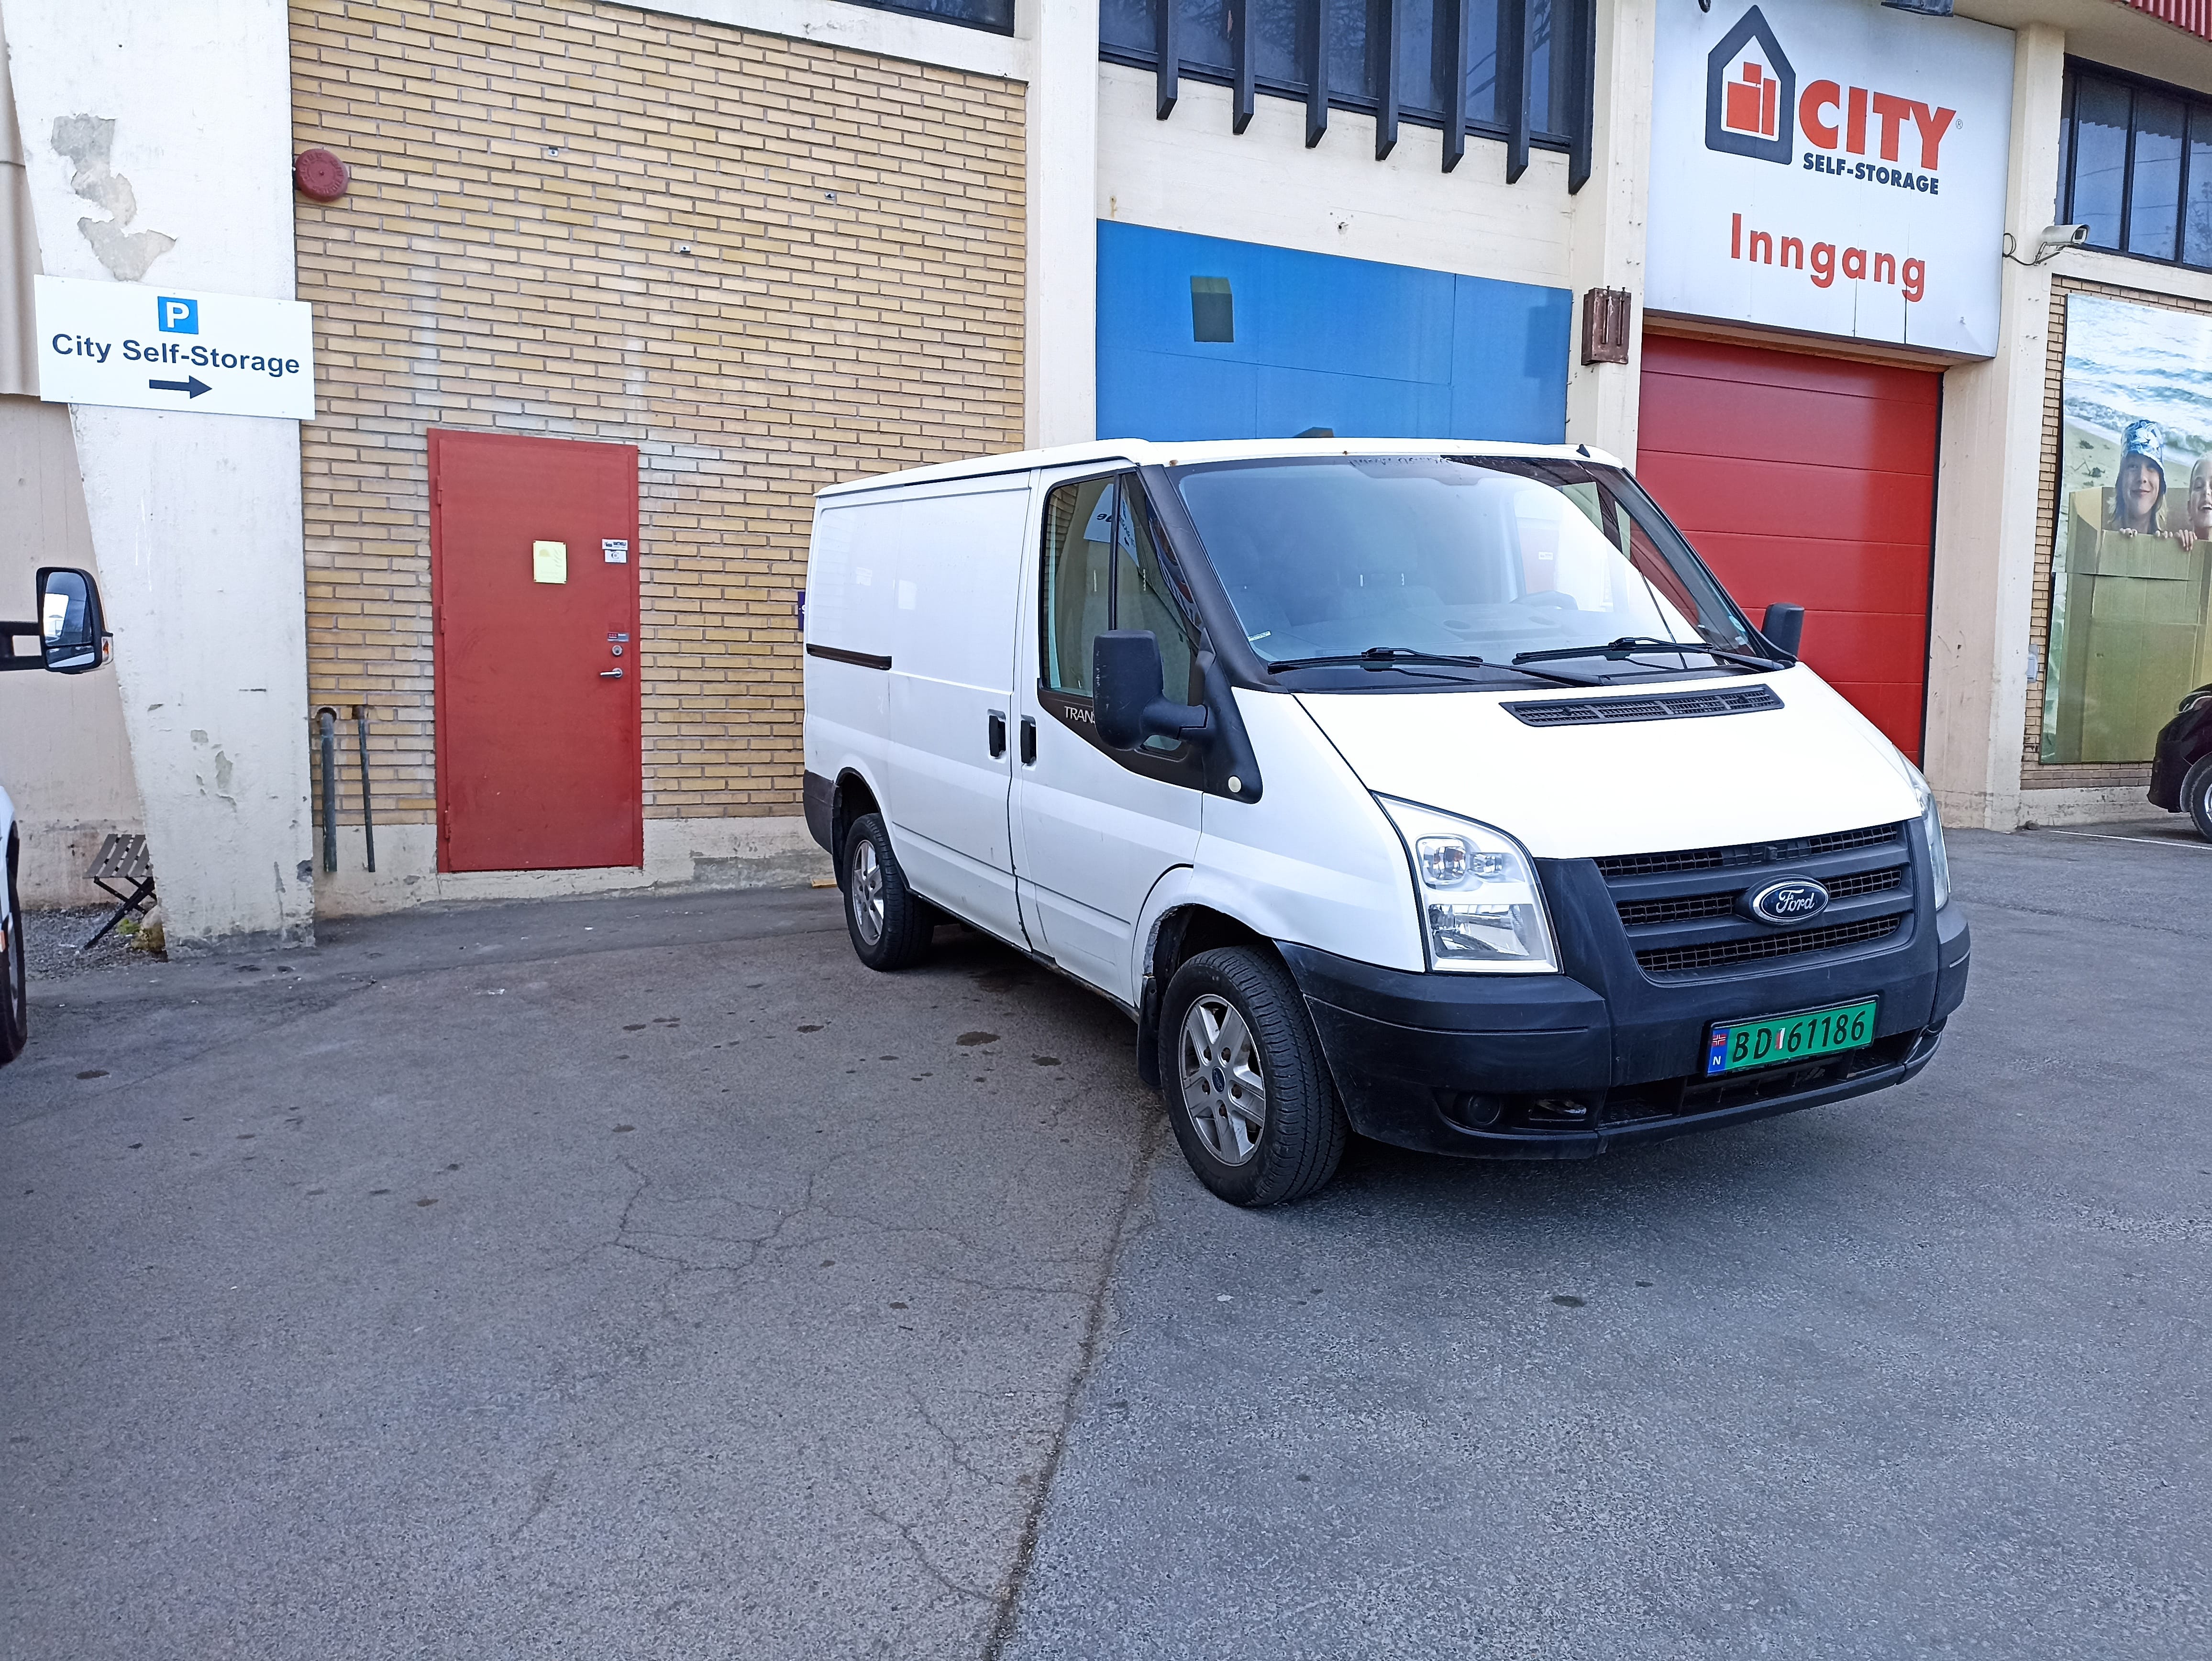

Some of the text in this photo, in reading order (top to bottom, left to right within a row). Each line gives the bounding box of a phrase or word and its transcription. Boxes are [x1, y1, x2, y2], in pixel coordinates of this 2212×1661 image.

[1799, 79, 1957, 171] CITY
[1803, 153, 1939, 195] SELF-STORAGE
[1731, 212, 1925, 302] Inngang
[166, 301, 189, 328] P
[52, 333, 300, 377] City Self-Storage
[1064, 706, 1095, 724] TRAN
[1776, 888, 1815, 914] Ford
[1713, 1055, 1722, 1066] N
